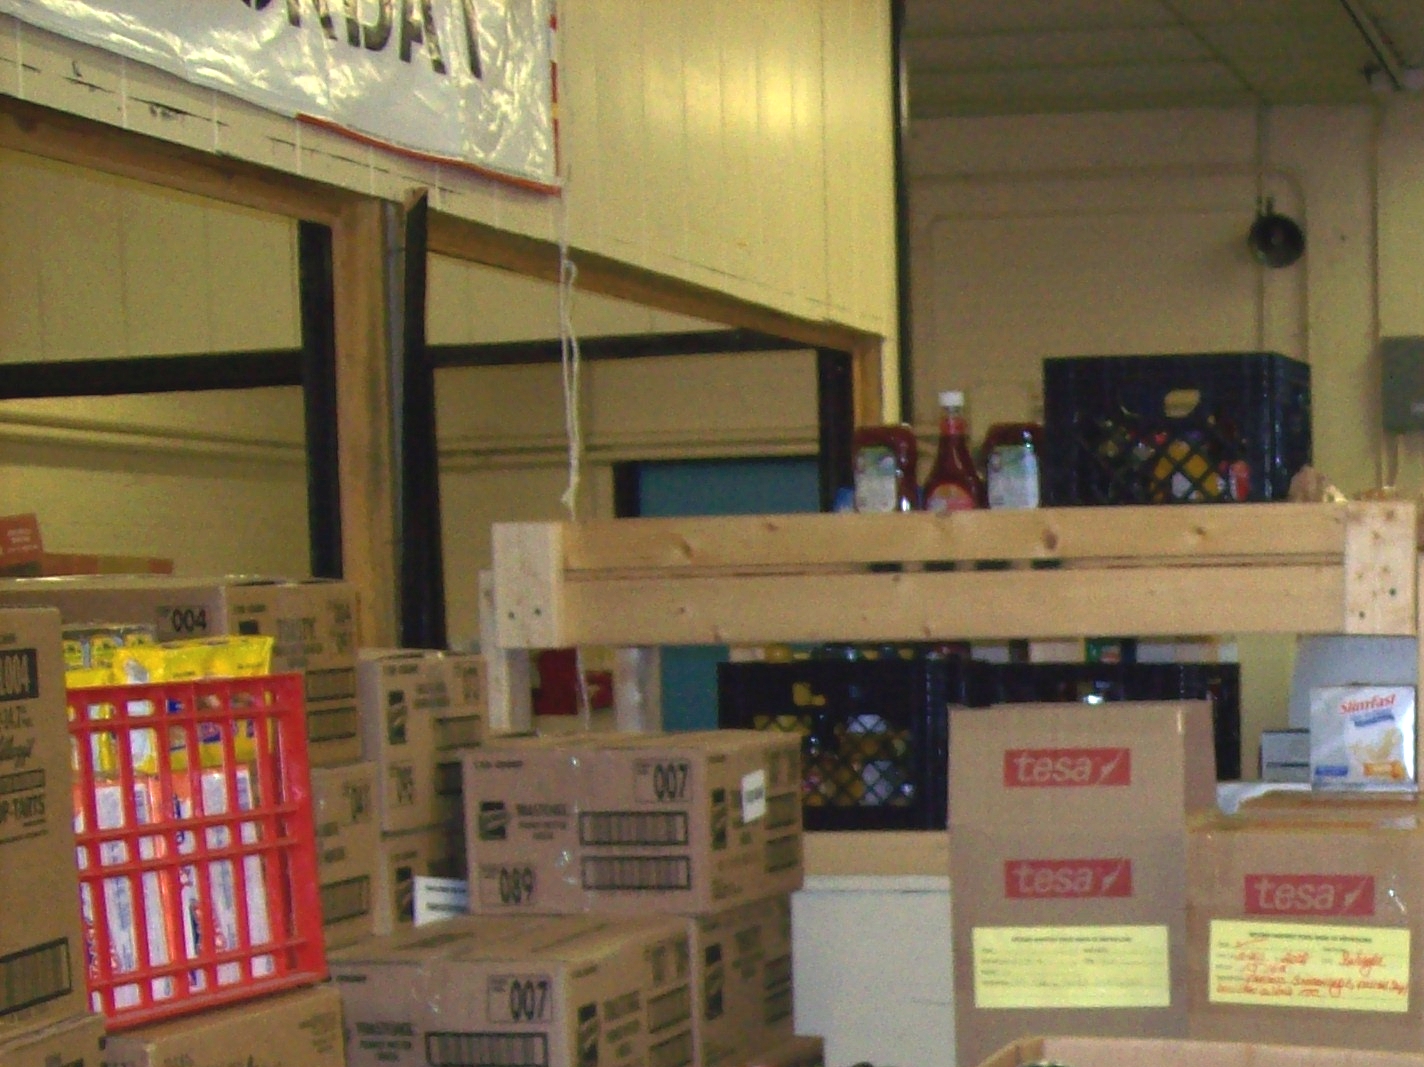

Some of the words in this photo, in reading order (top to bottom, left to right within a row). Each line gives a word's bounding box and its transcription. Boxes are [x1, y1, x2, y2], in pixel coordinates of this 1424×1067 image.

[171, 608, 208, 633] 004
[653, 763, 688, 801] 007
[1014, 752, 1092, 782] tesa
[1014, 863, 1093, 893] tesa
[1254, 877, 1335, 910] tesa
[509, 979, 548, 1022] 007
